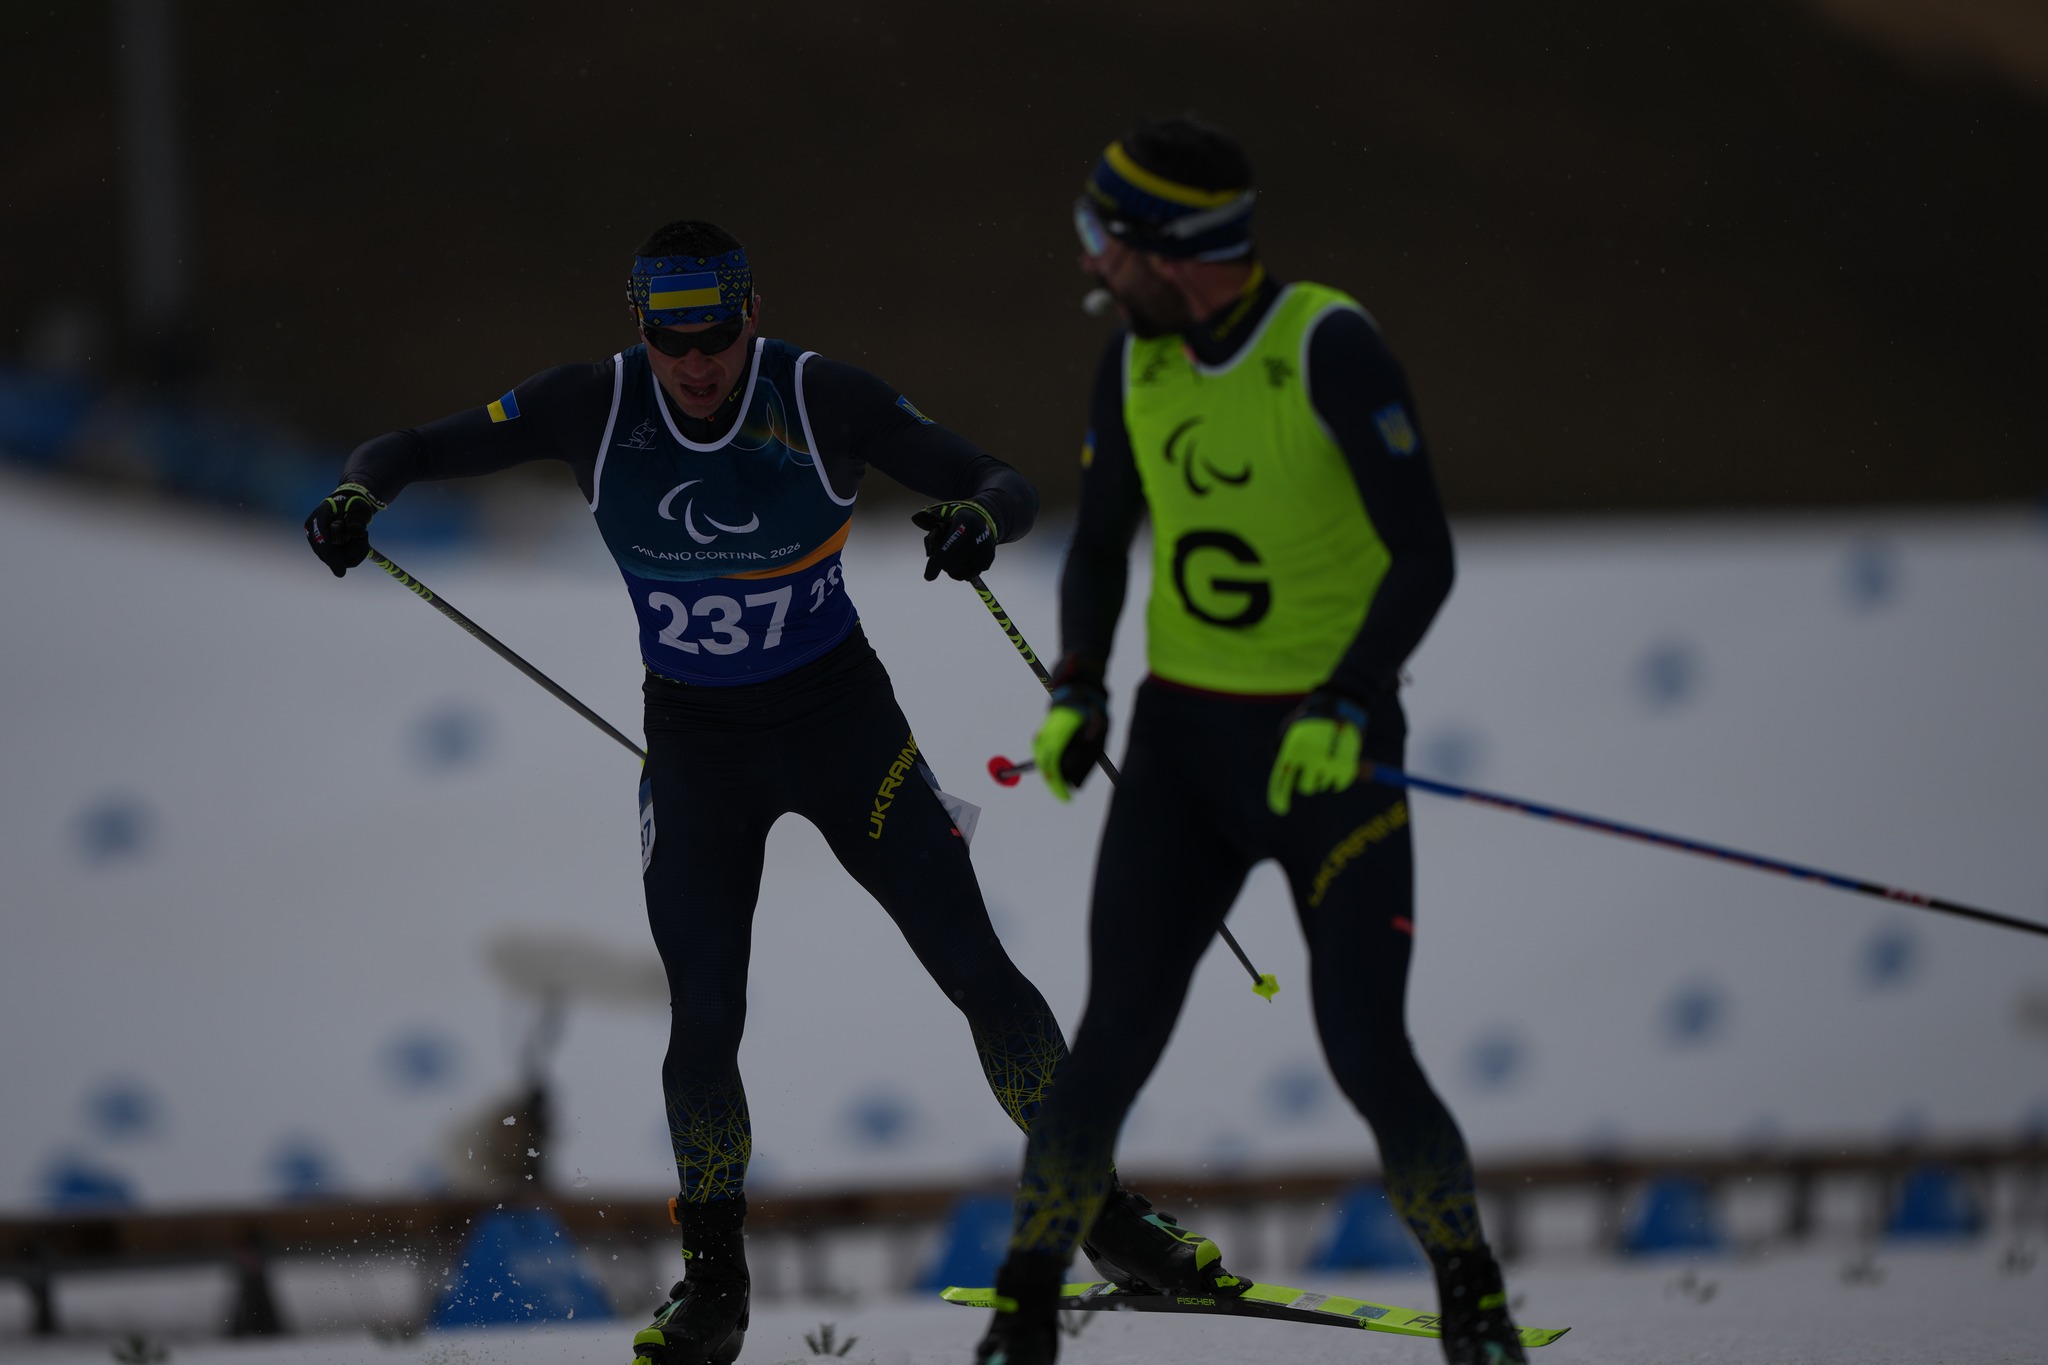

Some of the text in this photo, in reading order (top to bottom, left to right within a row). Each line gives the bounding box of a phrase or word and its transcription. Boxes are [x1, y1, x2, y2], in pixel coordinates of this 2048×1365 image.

[632, 542, 801, 561] MILANO CORTINA 2026
[1175, 531, 1270, 627] G
[648, 585, 793, 655] 237
[1177, 1297, 1216, 1306] FISCHER
